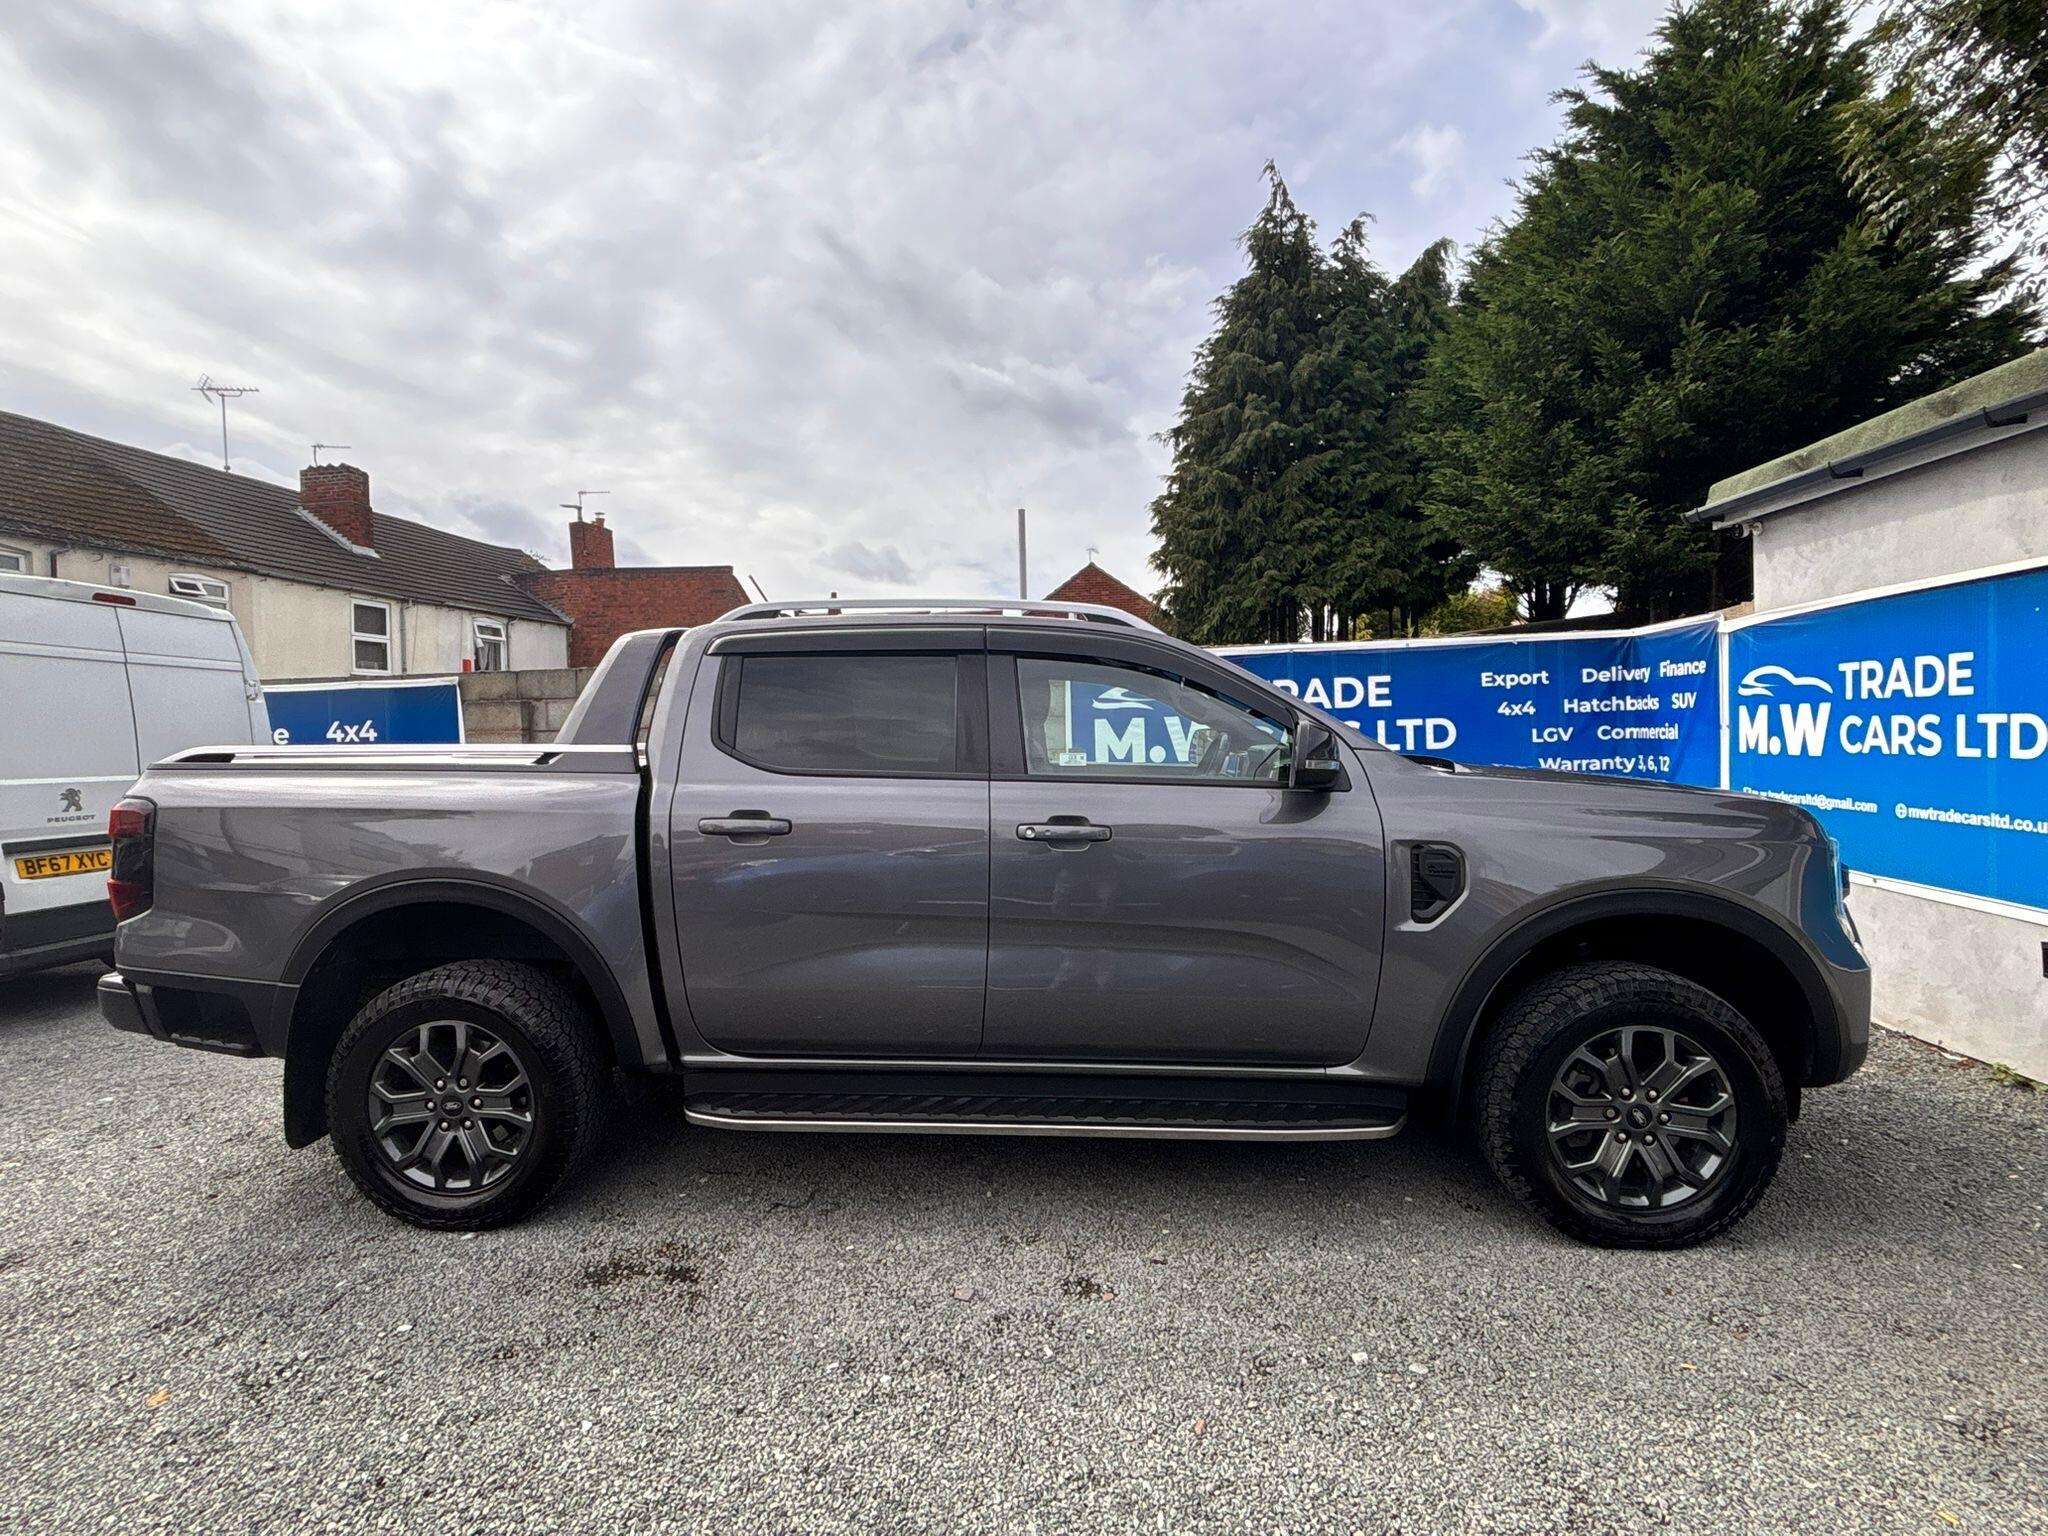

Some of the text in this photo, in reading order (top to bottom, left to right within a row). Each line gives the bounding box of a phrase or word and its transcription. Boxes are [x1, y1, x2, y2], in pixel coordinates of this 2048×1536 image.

[1481, 659, 1707, 690] Export Delivery Finance
[1838, 651, 1975, 701] TRADE
[1267, 675, 1392, 709] RADE
[1497, 692, 1697, 716] 4x4 Hatchbacks SUV
[326, 720, 378, 743] 4x4
[1377, 717, 1457, 751] LTD
[1531, 722, 1679, 743] LGV Commercial
[1737, 701, 2048, 760] M.W CARS LTD
[1538, 756, 1636, 773] Warranty
[1658, 754, 1670, 771] 12
[46, 814, 96, 823] PEUGEOT
[23, 852, 108, 875] BF67 XYC
